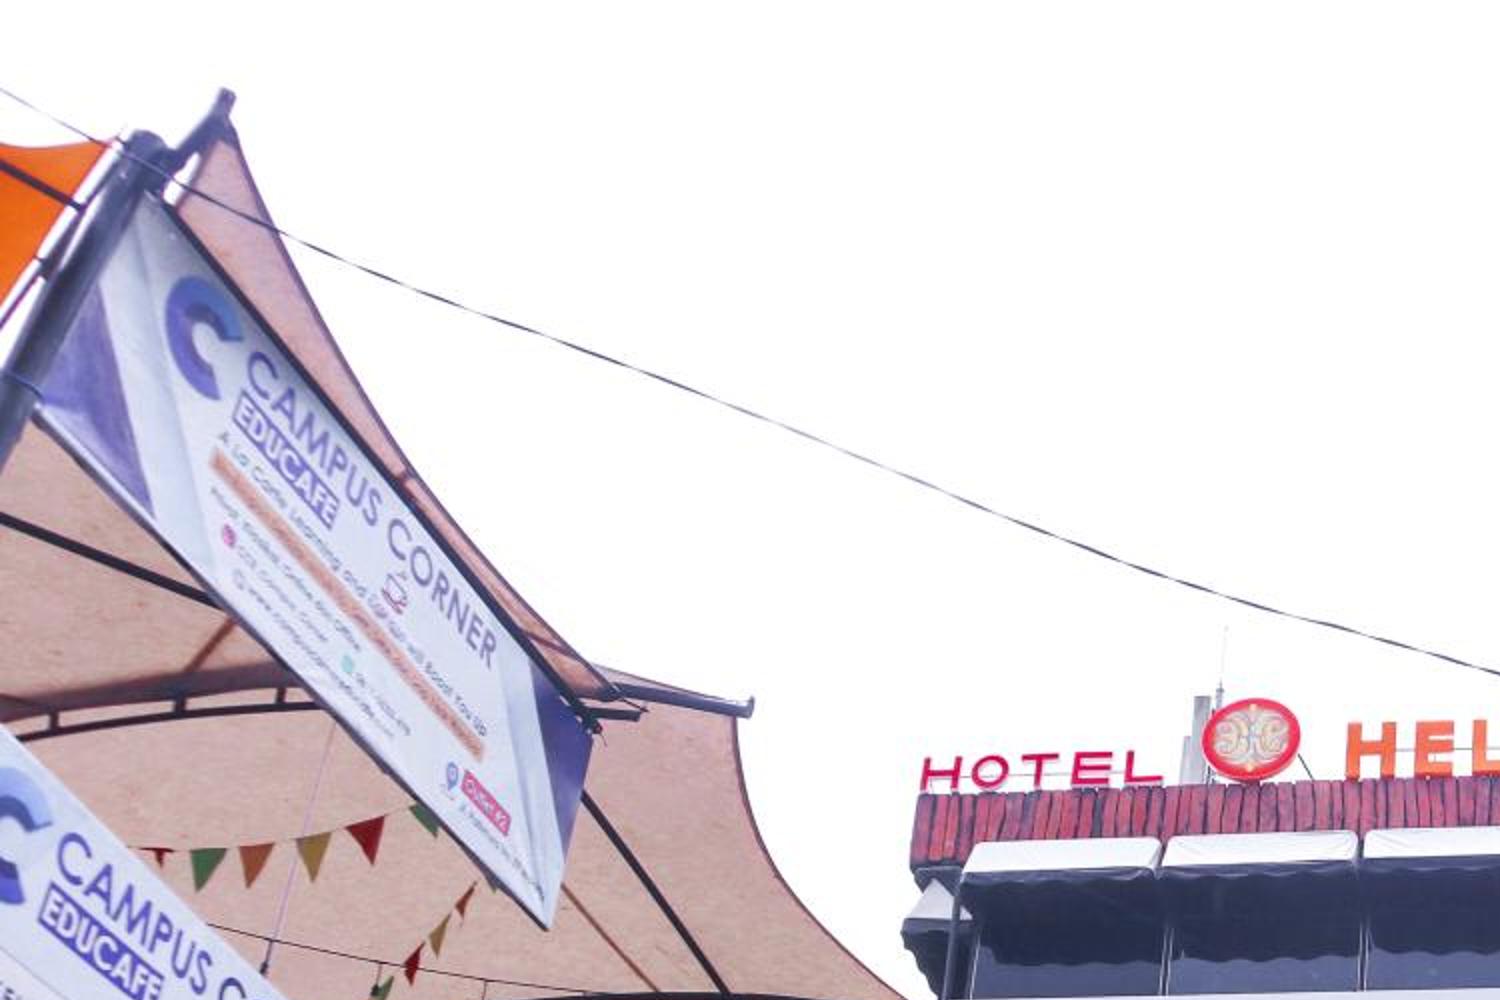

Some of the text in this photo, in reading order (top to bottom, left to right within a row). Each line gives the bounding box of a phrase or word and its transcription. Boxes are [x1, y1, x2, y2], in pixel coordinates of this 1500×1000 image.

[236, 403, 339, 528] EDUCAFE
[248, 351, 383, 528] CAMPUS
[388, 517, 497, 669] CORNER
[921, 749, 1164, 791] HOTEL
[57, 833, 212, 996] CAMPUS
